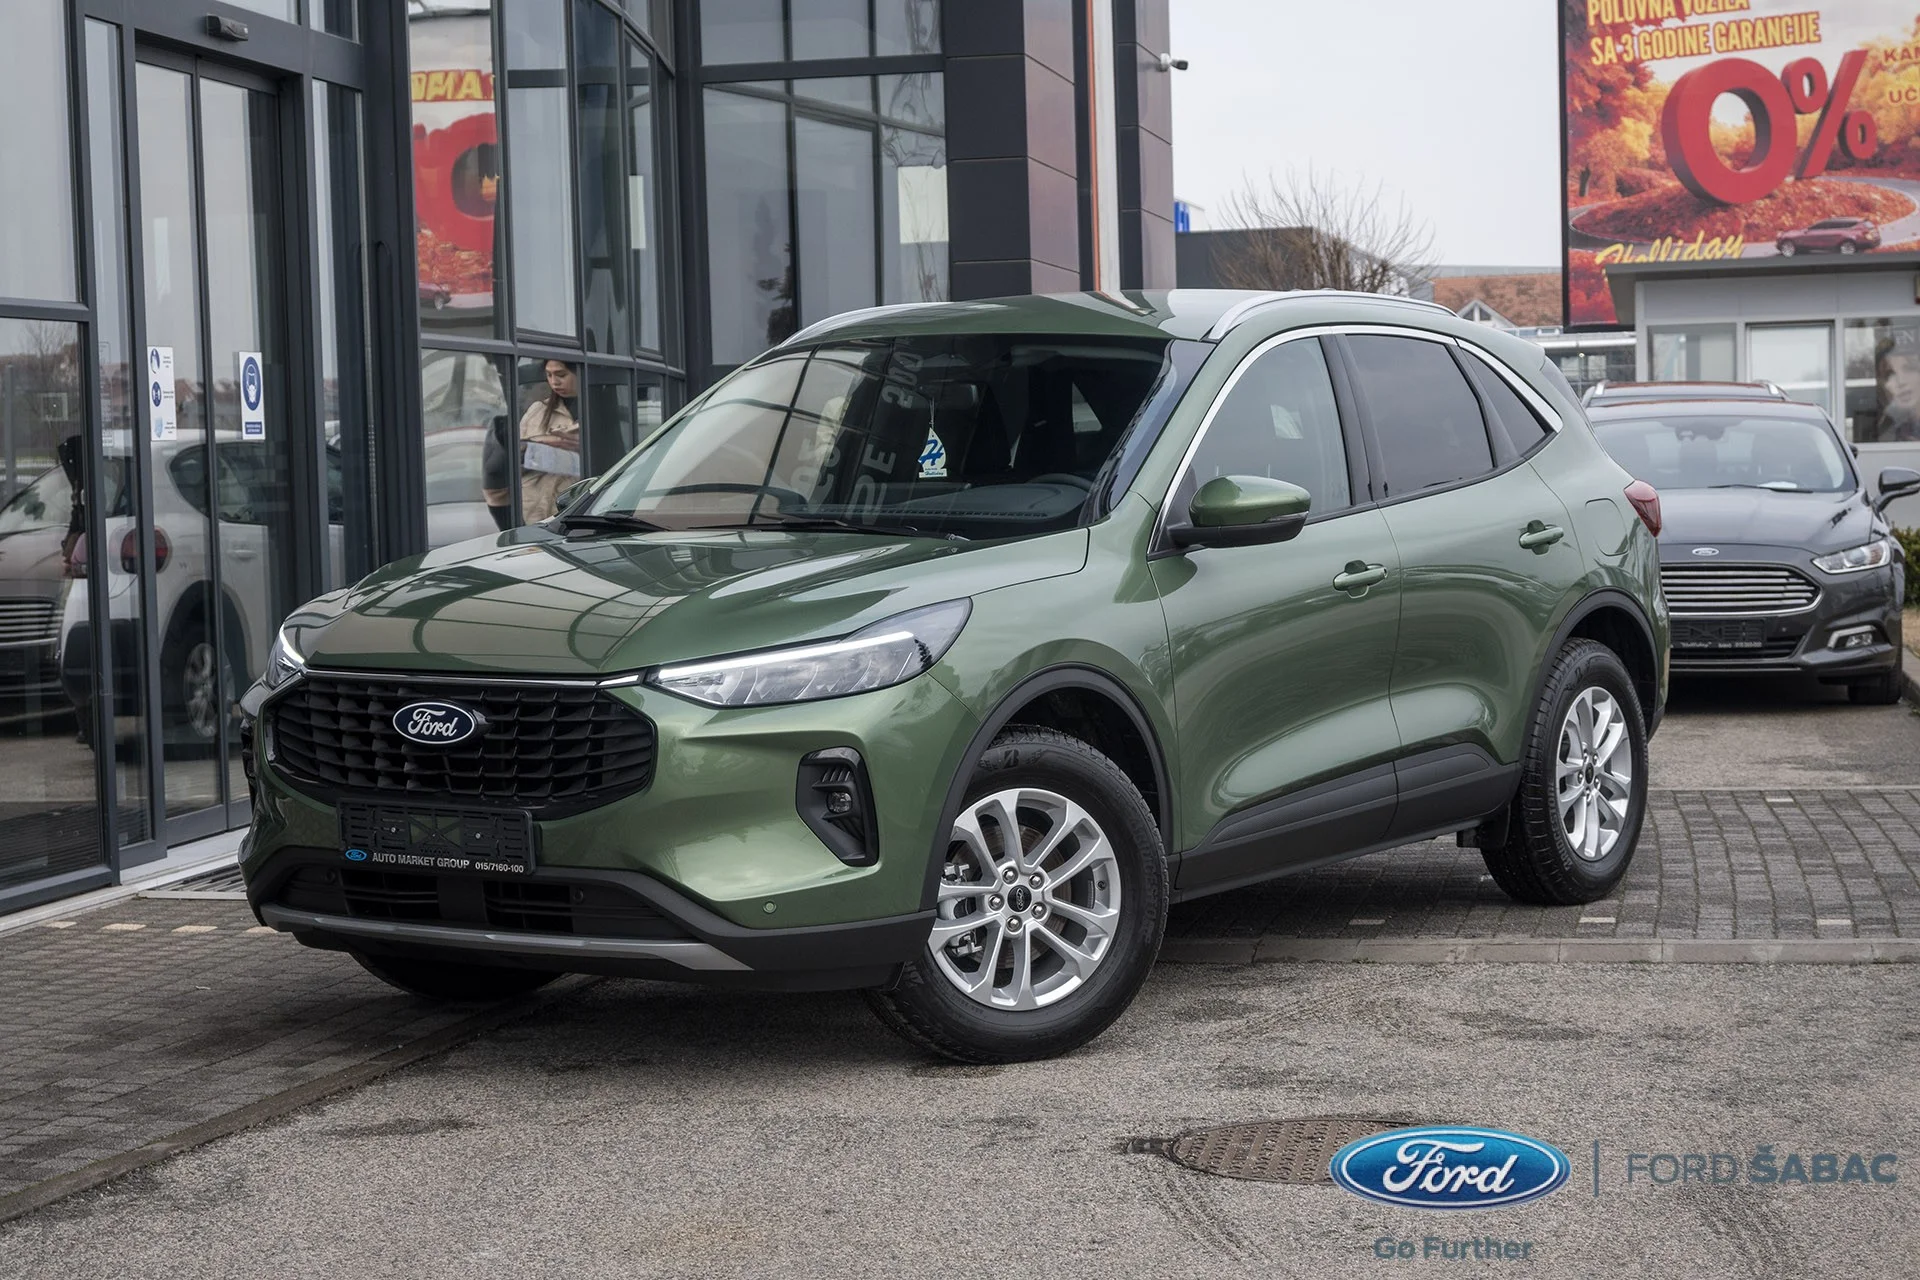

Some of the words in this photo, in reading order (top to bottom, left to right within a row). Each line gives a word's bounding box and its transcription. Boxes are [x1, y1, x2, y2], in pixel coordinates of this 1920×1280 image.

[1587, 0, 1676, 26] POLOVNA
[1590, 35, 1618, 66] SA
[1621, 33, 1635, 63] 3
[1637, 23, 1711, 62] GODINE
[1713, 12, 1822, 53] GARANCIJE
[1662, 50, 1878, 205] 0%
[407, 707, 459, 737] Ford
[372, 852, 397, 864] AUTO
[397, 854, 435, 867] MARKET
[436, 858, 470, 869] GROUP
